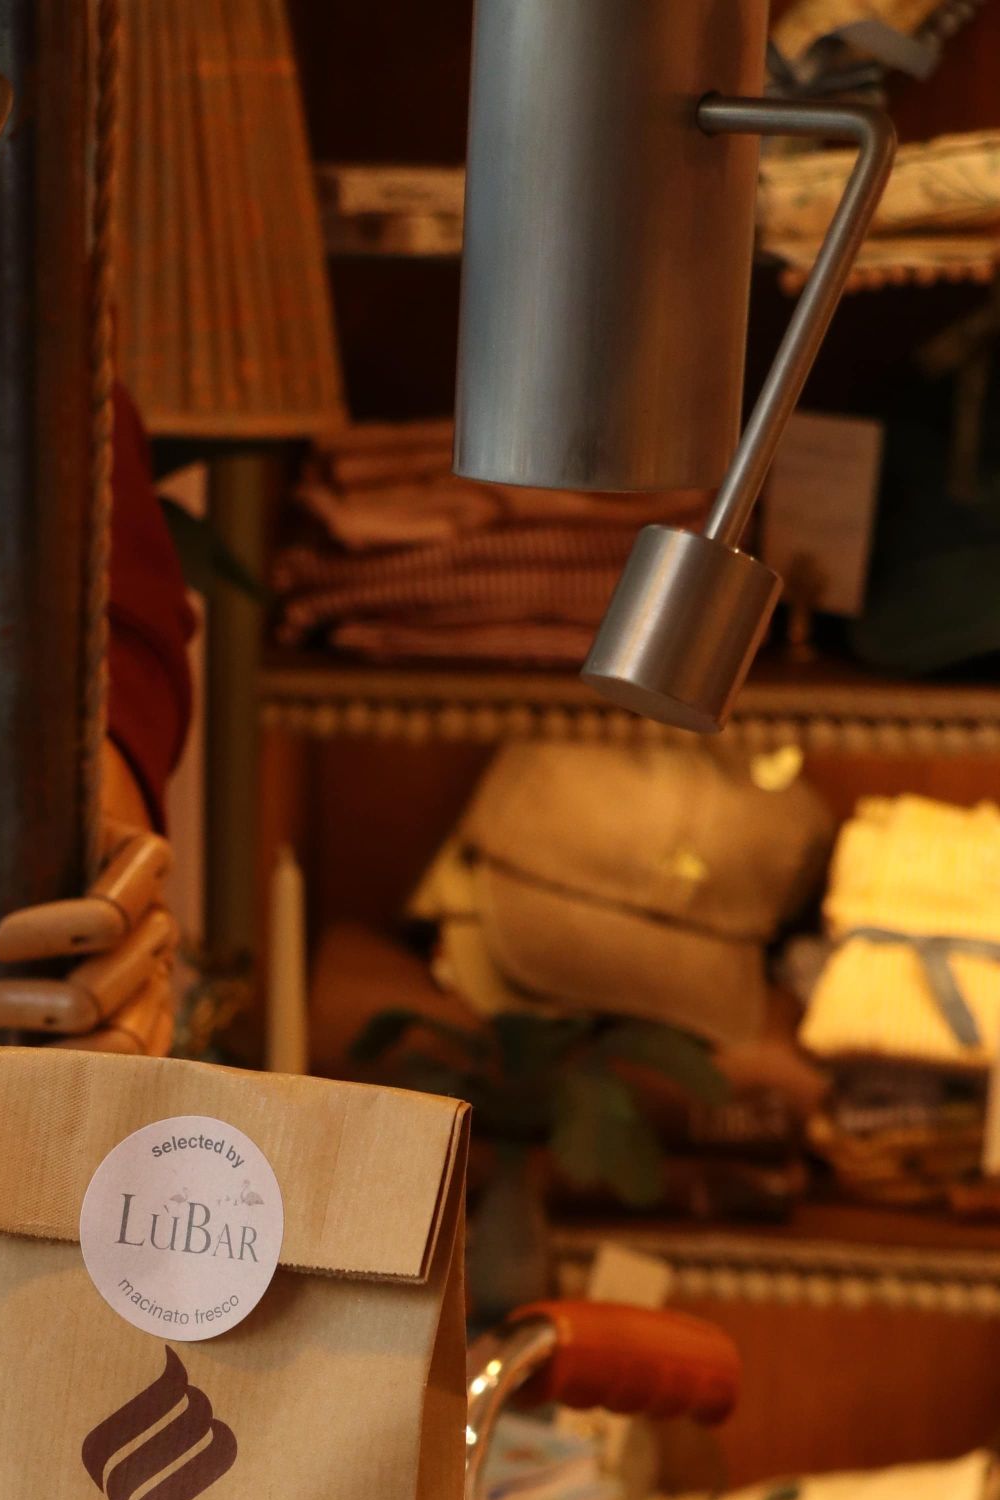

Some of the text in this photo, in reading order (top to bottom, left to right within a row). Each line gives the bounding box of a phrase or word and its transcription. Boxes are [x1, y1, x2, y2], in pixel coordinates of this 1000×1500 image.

[152, 1134, 246, 1169] selected by
[118, 1278, 240, 1325] macinato fresco
